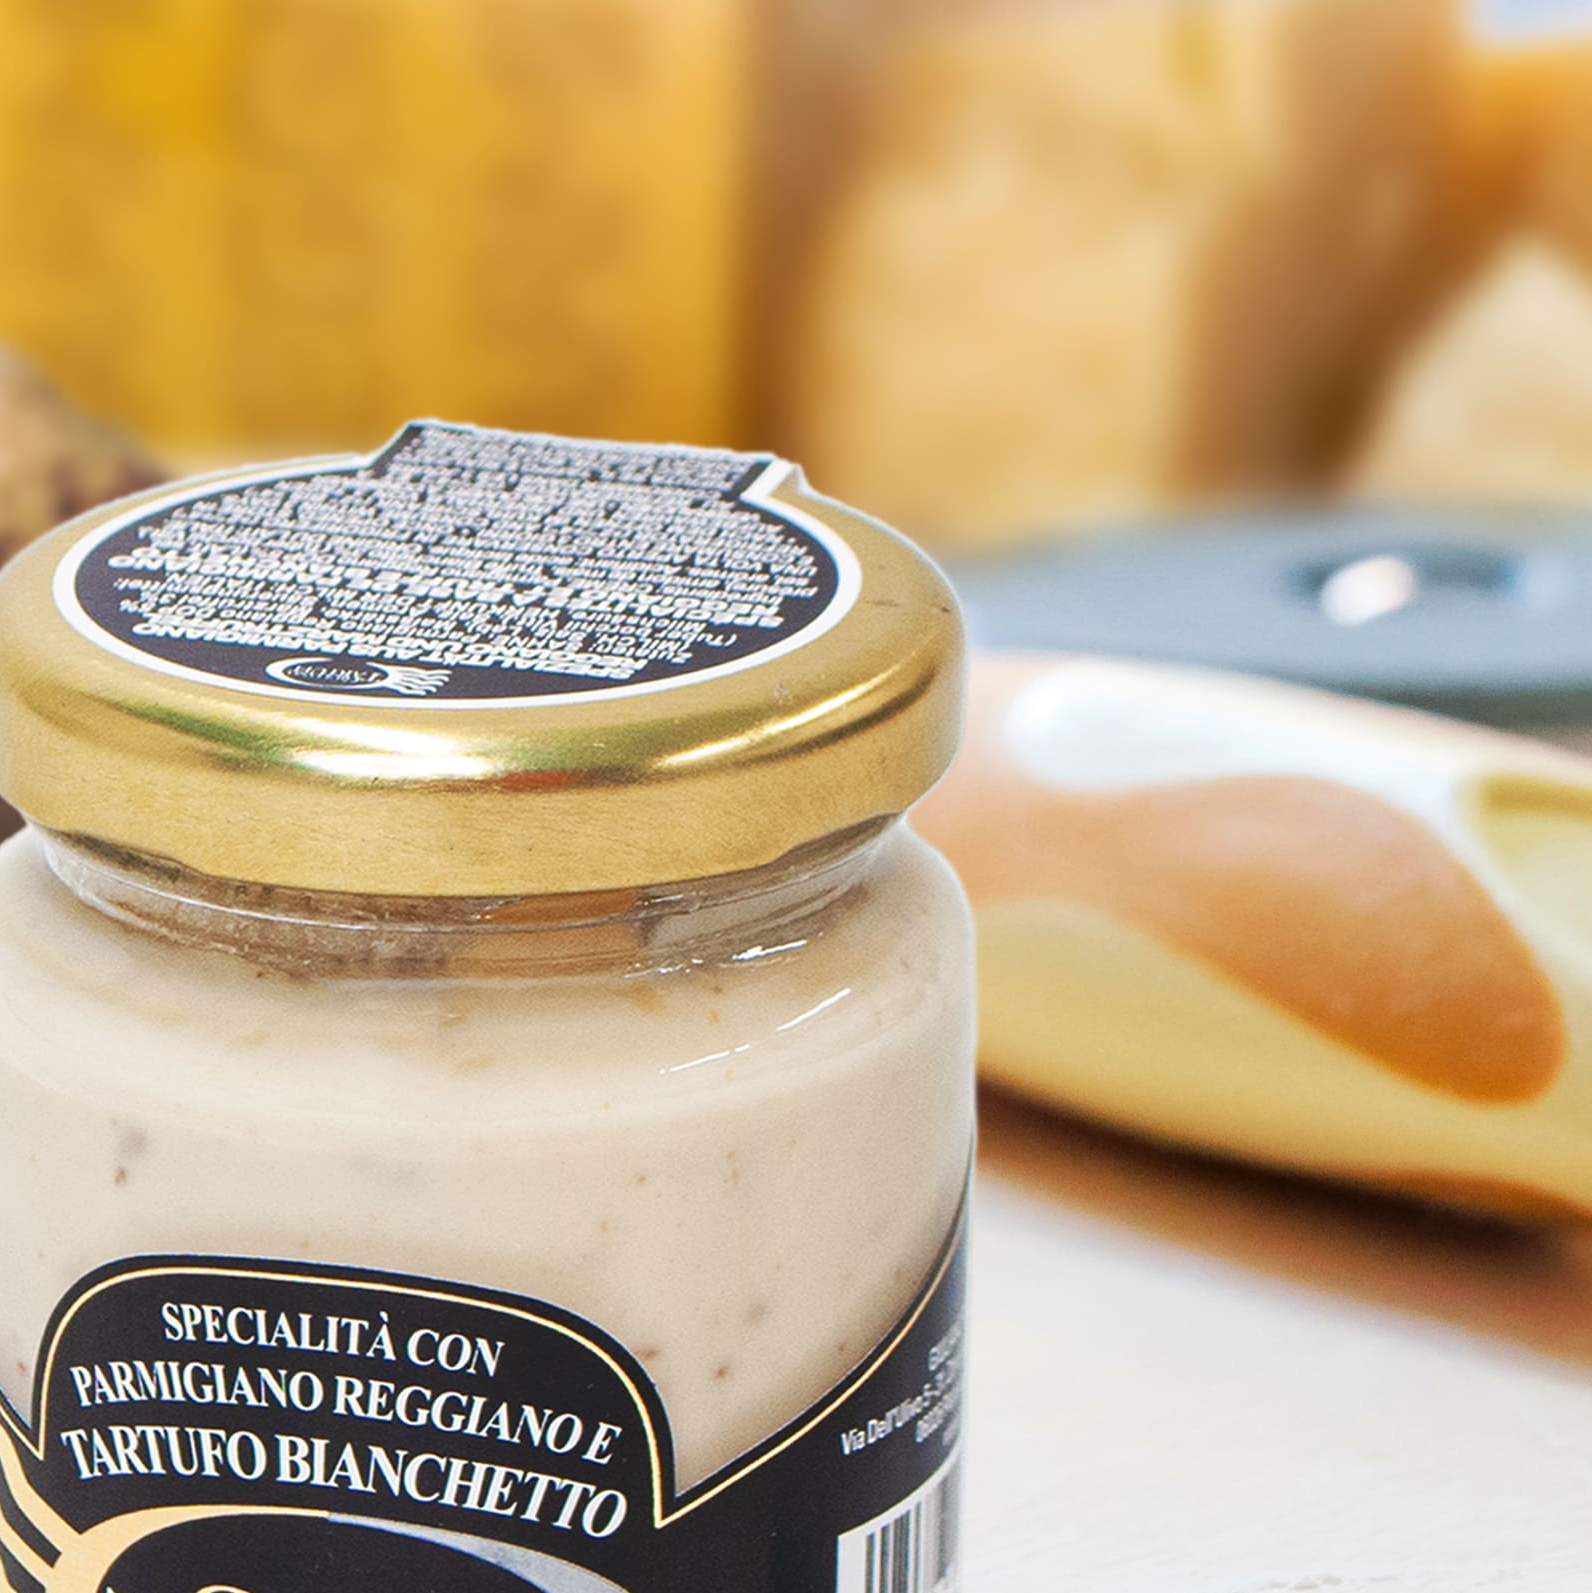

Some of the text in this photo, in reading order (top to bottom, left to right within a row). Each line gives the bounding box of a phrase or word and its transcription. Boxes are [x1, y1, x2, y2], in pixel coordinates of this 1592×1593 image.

[133, 622, 348, 654] PARMIGIANO
[348, 642, 423, 661] AUS
[387, 634, 465, 653] UND
[161, 1302, 505, 1376] SPECIALITÀ CON
[69, 1360, 623, 1466] PARMIGIANO REGGIANO E
[840, 1428, 867, 1456] Via
[60, 1425, 629, 1539] TARTUFO BIANCHETTO
